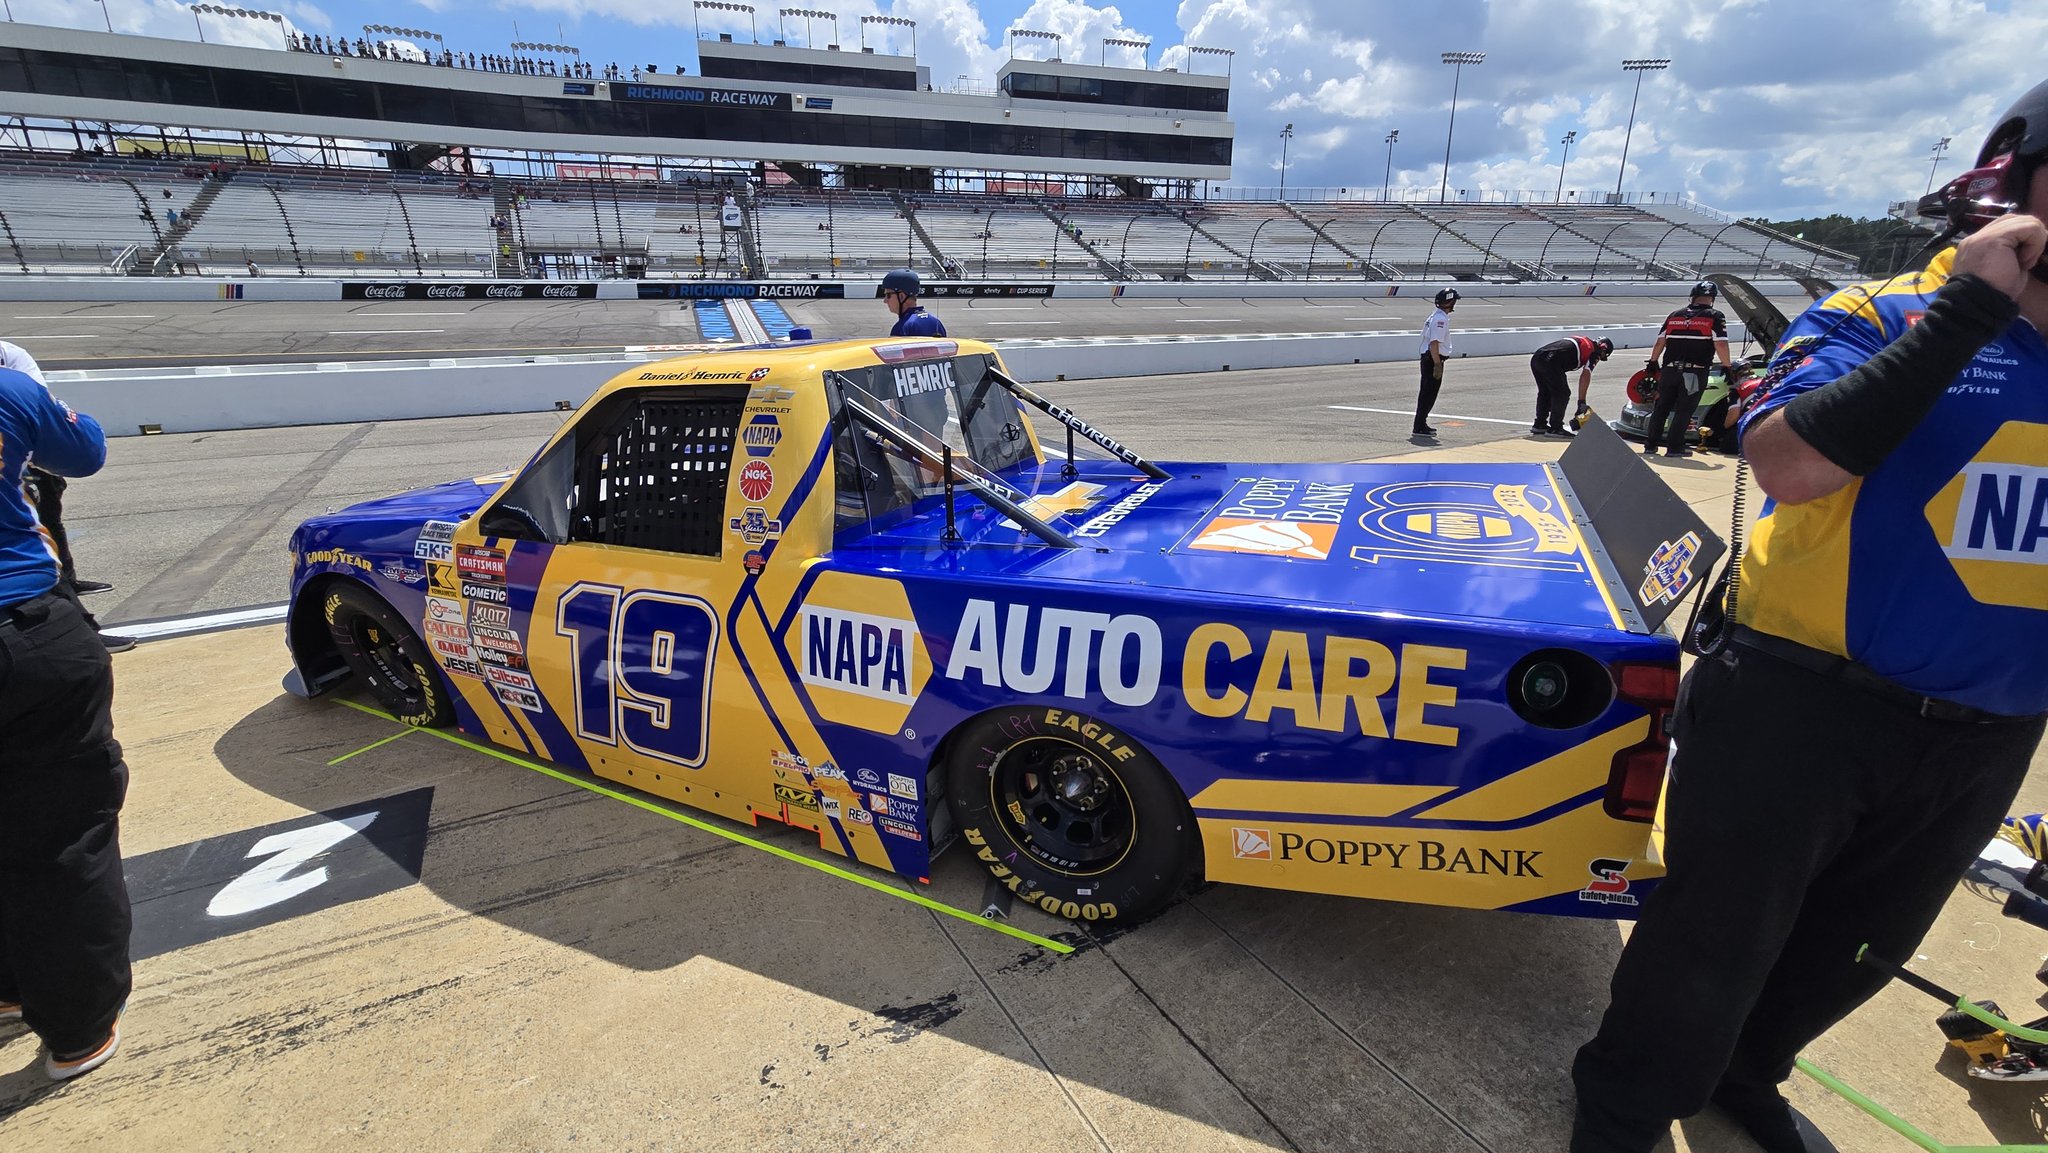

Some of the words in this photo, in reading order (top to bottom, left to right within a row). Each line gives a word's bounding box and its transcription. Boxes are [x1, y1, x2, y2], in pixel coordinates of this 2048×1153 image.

[627, 86, 704, 102] RICHMOND
[710, 91, 777, 106] RACEWAY
[680, 285, 755, 297] RICHMOND
[759, 285, 820, 297] RACEWAY
[637, 371, 683, 381] Daniel
[692, 369, 747, 380] Hemric
[893, 361, 955, 397] HEMRIC
[1973, 367, 2007, 381] BANK
[745, 406, 792, 414] CHEVROLET
[748, 427, 775, 445] NAPA
[1047, 404, 1146, 467] CHEVROLET
[744, 469, 768, 481] NGK
[1219, 477, 1300, 519] POPPY
[1281, 482, 1354, 523] BANK
[1077, 483, 1164, 538] CHEVROLET
[1967, 473, 2048, 553] NA
[306, 547, 373, 573] GOODYEAR
[415, 542, 452, 560] SKF
[459, 557, 503, 573] CRAFTSMAN
[463, 584, 506, 602] COMETIC
[325, 593, 342, 625] EAGLE
[476, 606, 507, 623] KLOTZ
[473, 626, 511, 641] LINCOLN
[484, 638, 518, 651] WELDERS
[476, 646, 508, 667] Holley
[809, 614, 907, 695] NAPA
[443, 656, 484, 677] JESEL
[555, 580, 720, 770] 19
[945, 598, 1163, 707] AUTO
[1182, 622, 1467, 748] CARE
[488, 667, 532, 689] tilton
[1045, 709, 1136, 762] EAGLE
[778, 751, 809, 766] ENEOS
[814, 765, 849, 782] PEAK
[890, 775, 914, 785] ADAPTIVE
[852, 780, 888, 793] HYDRAULICS
[824, 801, 839, 810] WIX
[888, 797, 919, 813] POPPY
[889, 807, 916, 822] BANK
[881, 819, 913, 831] LINCOLN
[889, 827, 917, 839] WELDERS
[963, 828, 1118, 921] GOODYEAR
